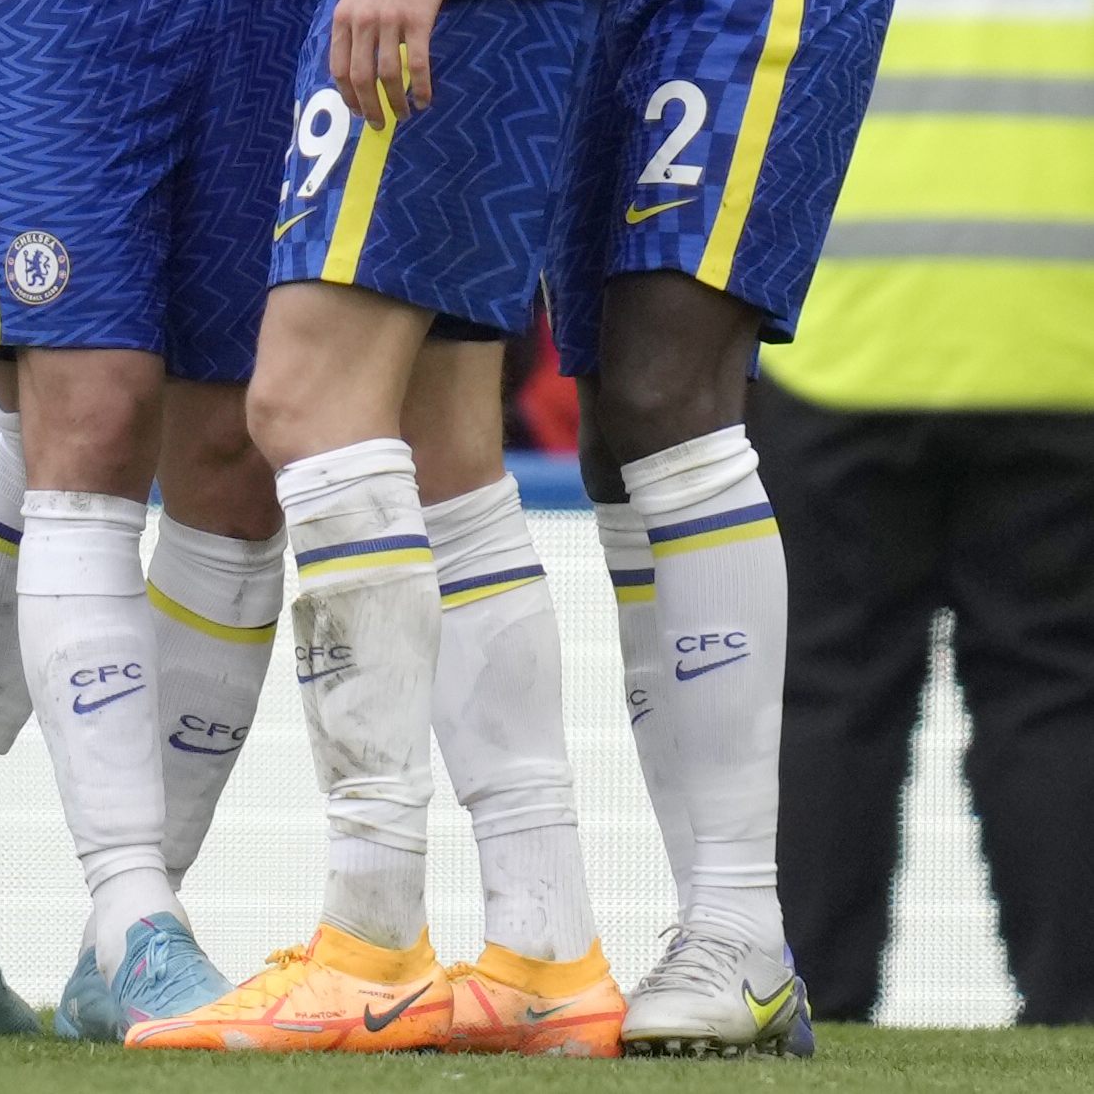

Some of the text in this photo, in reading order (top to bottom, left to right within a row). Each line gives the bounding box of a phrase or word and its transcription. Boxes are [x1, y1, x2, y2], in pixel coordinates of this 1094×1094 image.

[637, 80, 708, 186] 2
[279, 88, 351, 204] 9
[14, 233, 57, 251] CHELSEA
[295, 645, 353, 661] CFC
[675, 631, 747, 653] CFC
[70, 662, 143, 687] CFC
[179, 714, 249, 741] CFC
